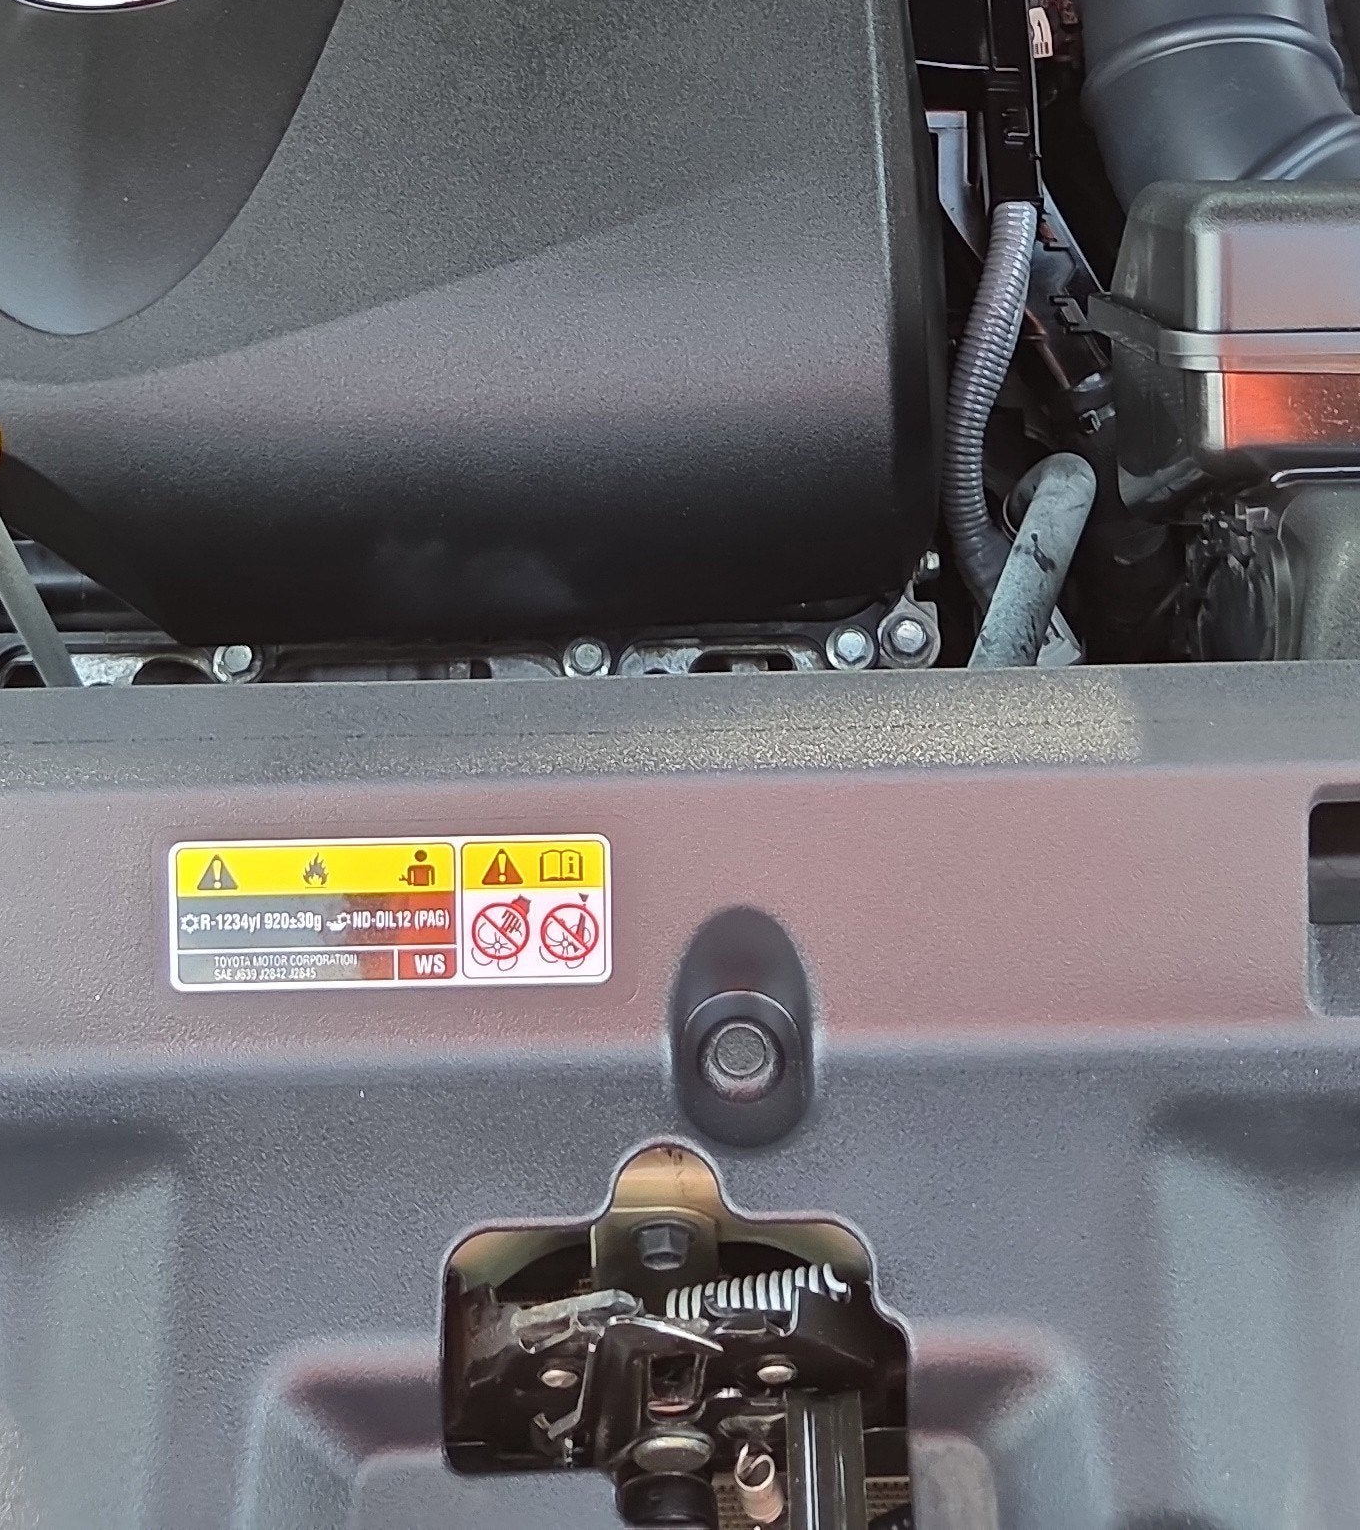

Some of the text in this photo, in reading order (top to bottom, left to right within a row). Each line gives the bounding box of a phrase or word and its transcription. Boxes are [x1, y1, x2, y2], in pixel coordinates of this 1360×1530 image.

[264, 910, 322, 932] 920±30g
[414, 909, 450, 930] (PAG)
[214, 953, 358, 967] TOYOTA MOTOR CORPORATION
[414, 953, 446, 975] WS
[214, 969, 233, 981] SAE
